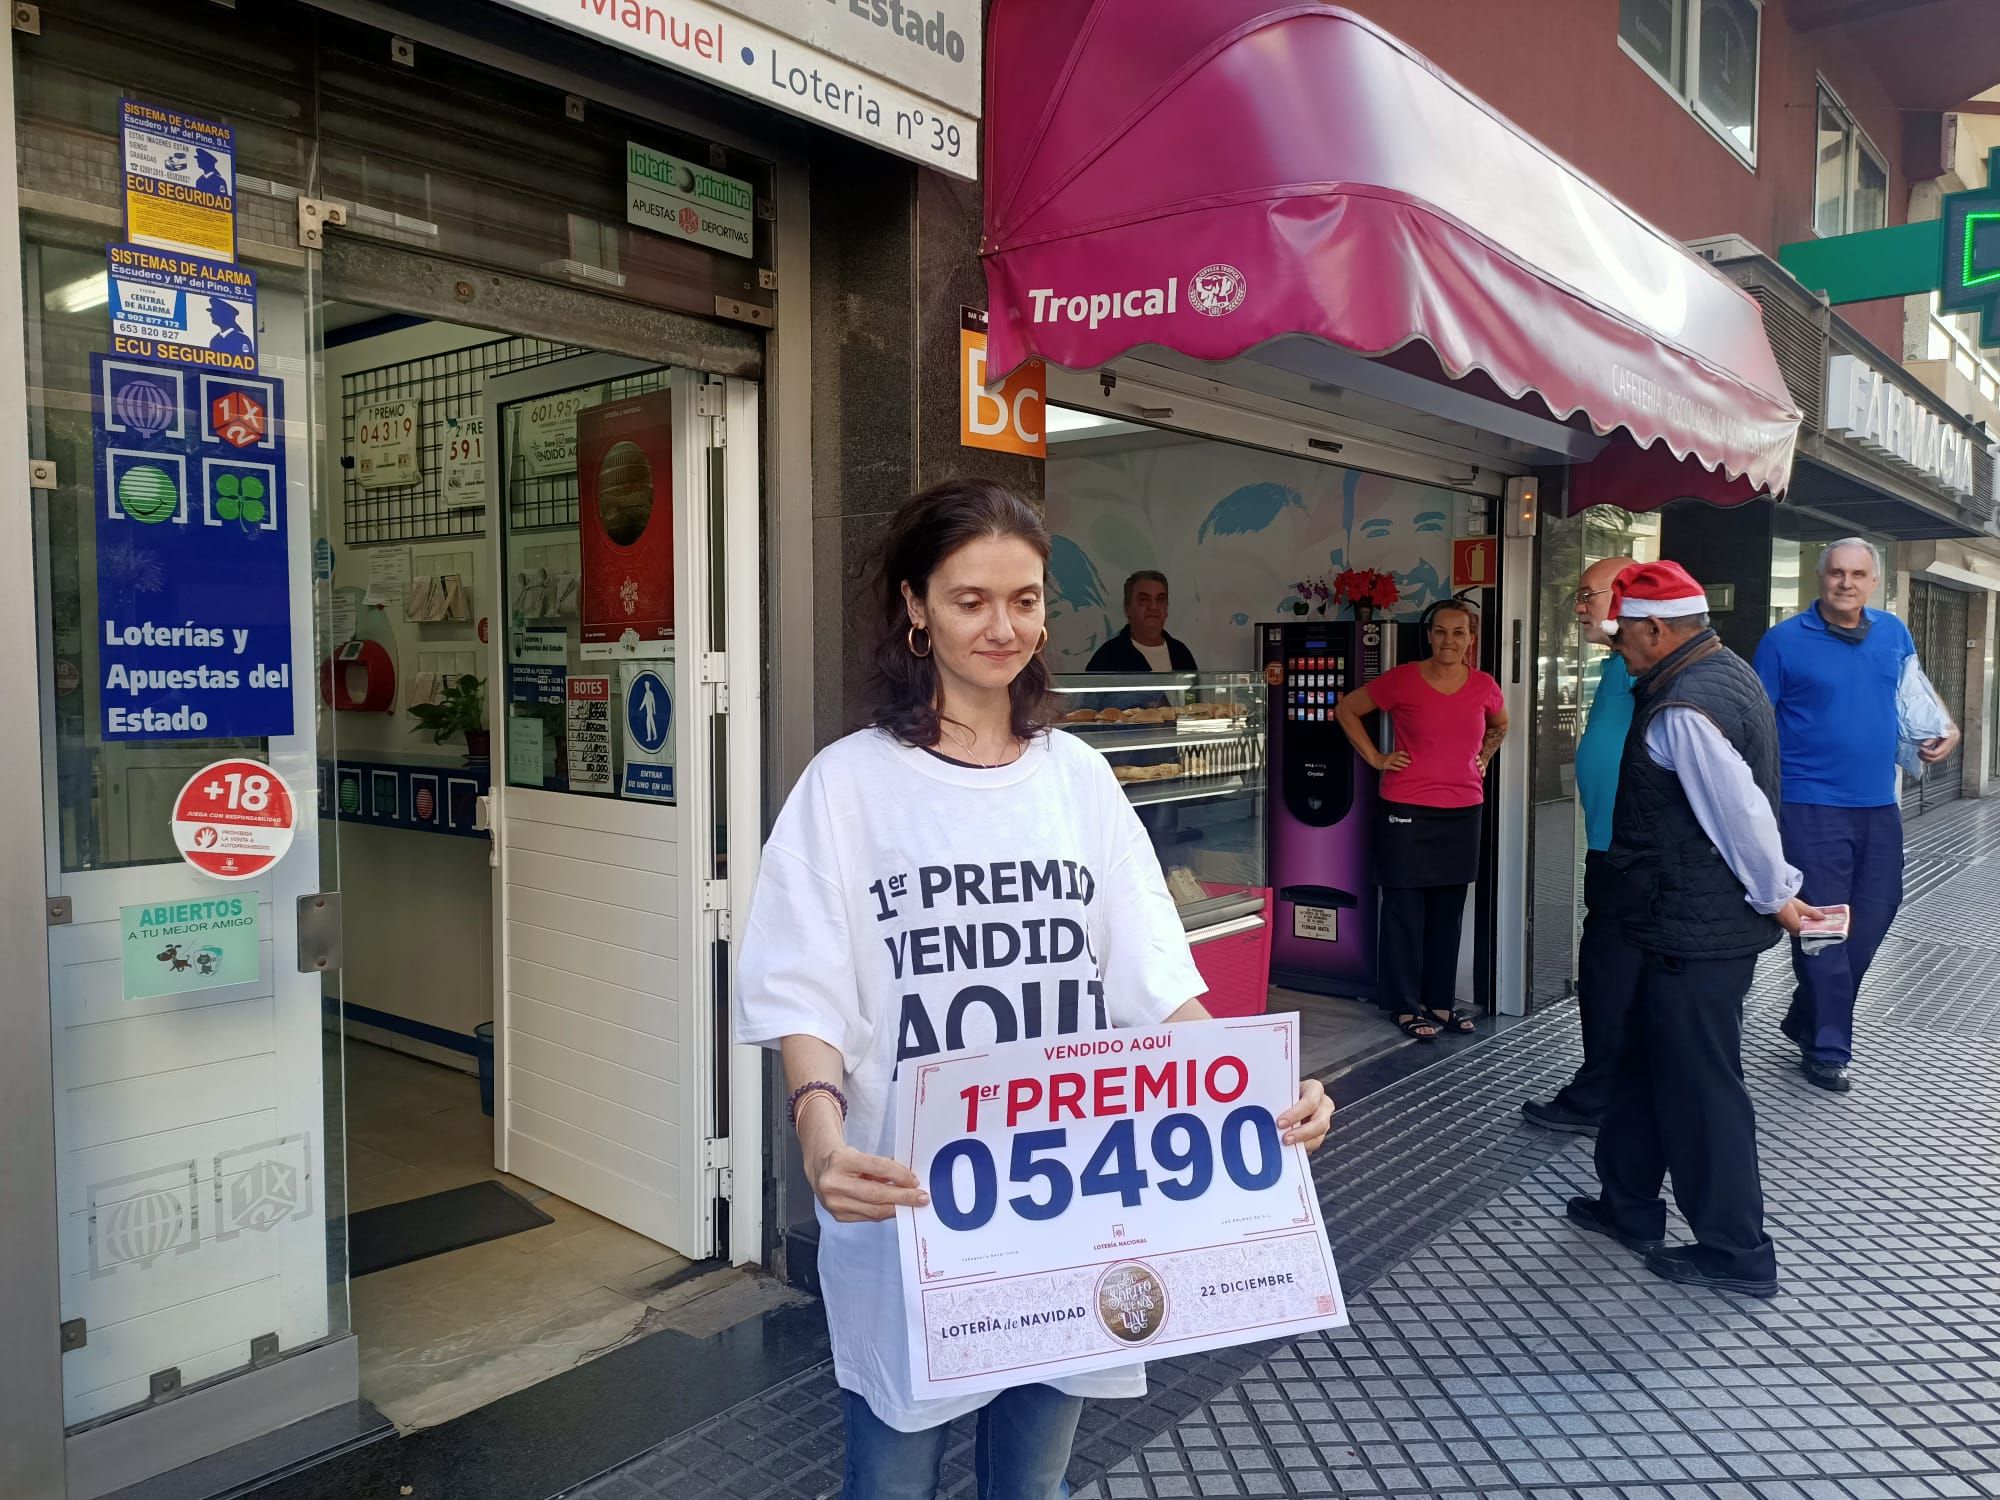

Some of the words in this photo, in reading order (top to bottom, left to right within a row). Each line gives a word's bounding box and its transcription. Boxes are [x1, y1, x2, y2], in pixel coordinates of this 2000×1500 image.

[772, 48, 881, 127] Loteria
[897, 110, 924, 140] nº
[931, 117, 961, 158] 39
[124, 102, 167, 124] SISTEMA
[169, 114, 182, 127] DE
[184, 119, 230, 139] CAMARAS
[124, 114, 162, 130] Escudero
[164, 125, 169, 133] y
[182, 129, 194, 139] del
[128, 130, 145, 142] ESTAS
[129, 150, 158, 164] GRABADAS
[127, 174, 154, 193] ECU
[158, 182, 232, 211] SEGURIDAD
[632, 199, 675, 222] APUESTAS
[702, 220, 749, 244] DEPORTIVAS
[111, 248, 177, 273] SISTEMAS
[180, 261, 198, 276] DE
[200, 266, 252, 287] ALARMA
[111, 264, 163, 281] Escudero
[165, 275, 171, 284] y
[189, 278, 205, 289] del
[207, 282, 233, 294] Pino,
[125, 301, 136, 309] DE
[137, 304, 171, 315] ALARMA
[131, 294, 165, 306] CENTRAL
[1028, 278, 1178, 329] Tropical
[119, 323, 138, 334] 653
[141, 326, 159, 337] 820
[162, 329, 180, 340] 827
[127, 313, 144, 322] 902
[146, 315, 162, 325] 877
[164, 319, 180, 329] 172
[115, 337, 151, 356] ECU
[157, 343, 255, 371] SEGURIDAD
[374, 403, 405, 420] PREMIO
[531, 398, 580, 423] 601.952
[360, 417, 412, 444] 04319
[1848, 355, 1974, 497] FARMACIA
[450, 438, 481, 461] 591
[106, 620, 224, 647] Loterías
[232, 628, 249, 655] y
[106, 664, 240, 696] Apuestas
[249, 663, 289, 689] del
[573, 680, 602, 695] BOTES
[108, 705, 208, 733] Estado
[628, 780, 636, 788] DE
[652, 782, 660, 790] EN
[640, 770, 663, 779] ENTRAR
[203, 773, 270, 812] +18
[224, 813, 282, 824] RESPONSABILIDAD
[869, 872, 908, 922] 1er
[918, 859, 1095, 909] PREMIO
[139, 899, 242, 928] ABIERTOS
[128, 932, 138, 941] A
[140, 928, 159, 939] TU
[162, 922, 208, 936] MEJOR
[211, 917, 253, 930] AMIGO
[1044, 1040, 1123, 1061] VENDIDO
[1130, 1031, 1172, 1052] AQUÍ
[959, 1082, 1001, 1133] 1er
[1006, 1055, 1250, 1128] PREMIO
[929, 1104, 1284, 1232] 05490
[1093, 1240, 1117, 1250] LOTERÍA
[1118, 1238, 1148, 1247] NACIONAL
[1200, 1285, 1216, 1297] 22
[1220, 1272, 1295, 1294] DICIEMBRE
[941, 1316, 1002, 1339] LOTERÍA
[1003, 1318, 1018, 1331] de
[1020, 1306, 1086, 1328] NAVIDAD
